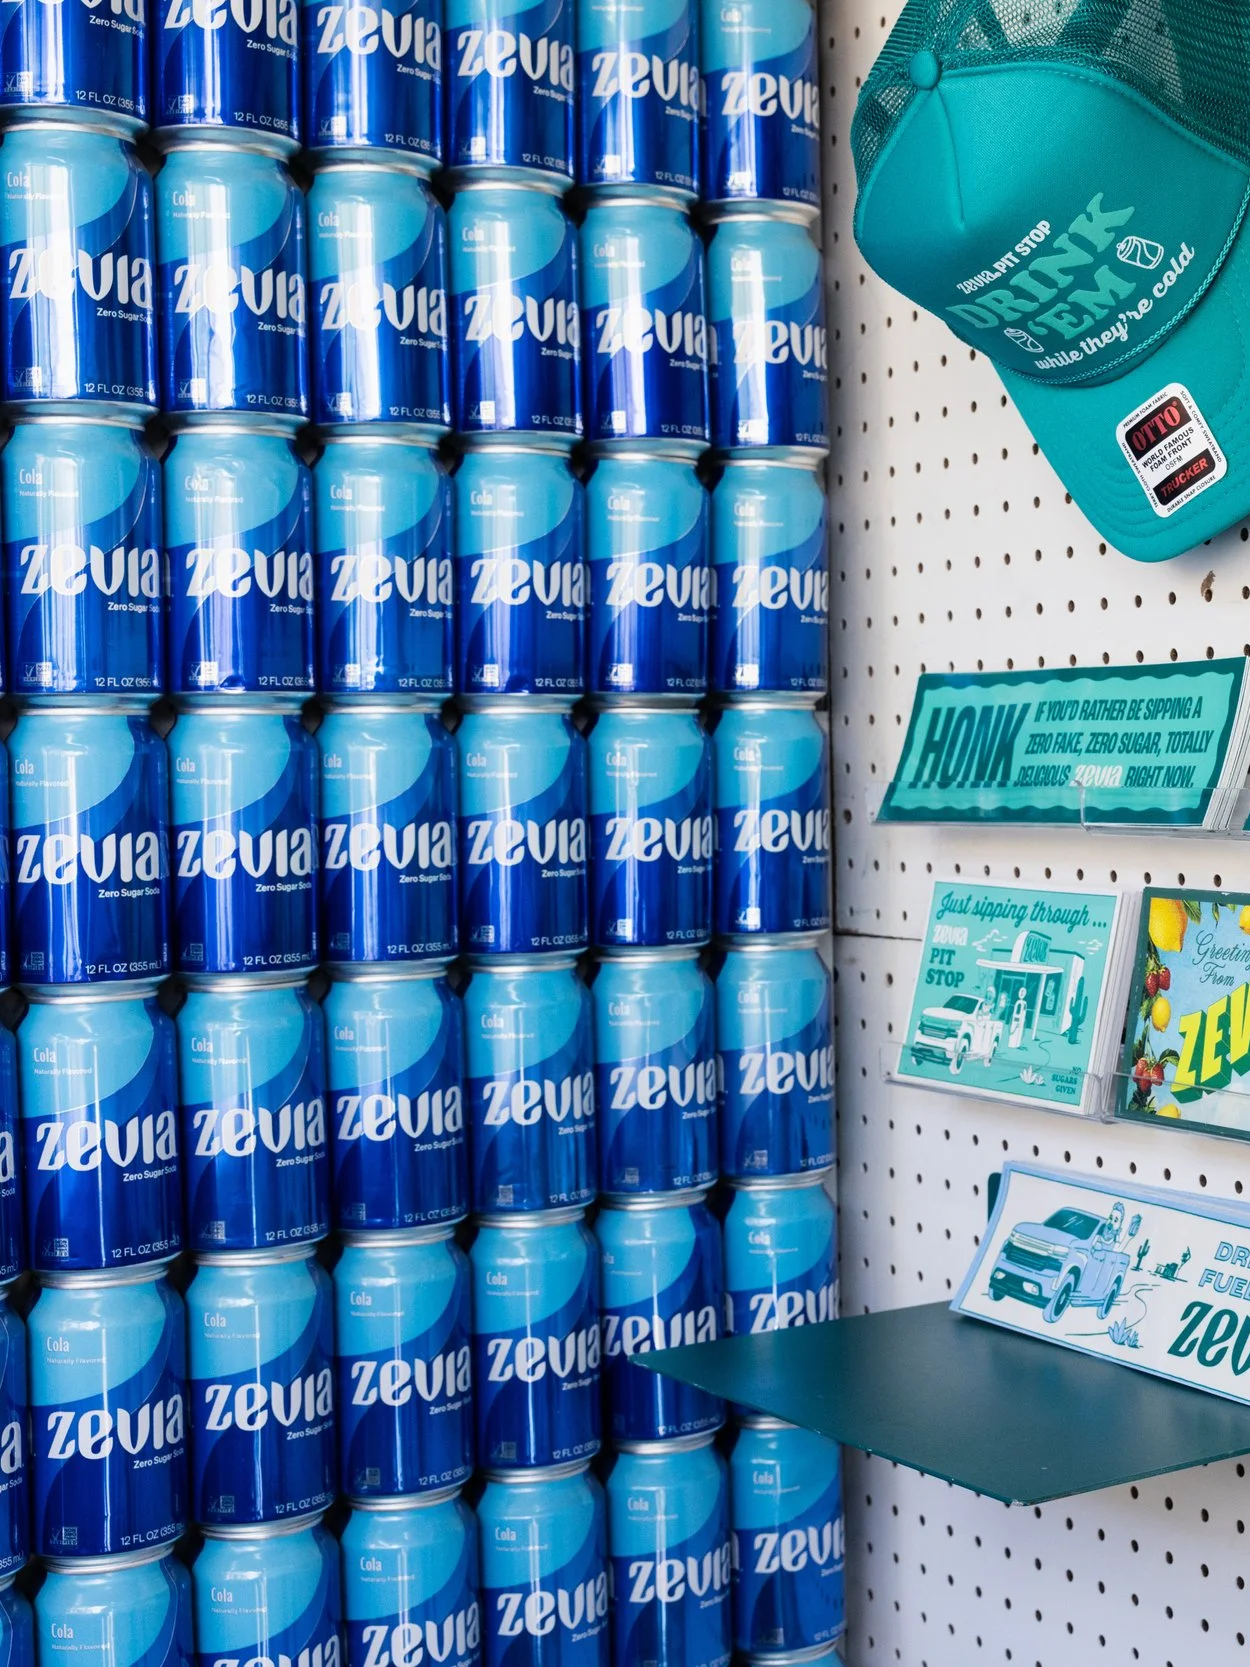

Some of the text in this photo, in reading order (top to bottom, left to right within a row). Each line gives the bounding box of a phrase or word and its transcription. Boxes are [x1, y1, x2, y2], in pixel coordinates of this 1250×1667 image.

[317, 5, 441, 71] zevia
[456, 30, 574, 92] zevia
[945, 192, 1136, 329] DRINK
[993, 251, 1019, 274] PIT
[1015, 220, 1051, 256] STOP
[9, 248, 152, 311] zevia
[174, 264, 306, 324] zevia
[320, 282, 448, 337] zevia
[464, 294, 581, 348] zevia
[1034, 242, 1195, 370] while they're cold
[1122, 392, 1168, 428] PREMIUM FOAM FABRIC
[1132, 406, 1180, 451] OTTO
[1180, 390, 1222, 463] SOFT COMFY SWEATBAND
[1142, 426, 1194, 468] WORLD FAMOUS
[1150, 437, 1193, 472] FOAM FRONT
[1164, 454, 1184, 471] OSFM
[20, 468, 44, 486] Cola
[1122, 442, 1159, 509] TERRY CLOTH SWEATBAND
[1160, 457, 1208, 497] TRUCKER
[1166, 475, 1216, 513] DURABLE SNAP CLOSURE
[20, 544, 161, 598] zevia
[186, 547, 314, 602] zevia
[330, 554, 453, 606] zevia
[470, 557, 588, 606] zevia
[606, 562, 716, 612] zevia
[1034, 696, 1203, 722] IF YOU'D RATHER BE SIPPING A
[912, 702, 1032, 789] HONK
[1024, 730, 1214, 758] ZERO FAKE, ZERO SUGAR, TOTALLY
[1013, 764, 1196, 788] DELICIOUS zevia RIGHT NOW.
[17, 830, 160, 885] zevia
[176, 826, 313, 880] zevia
[324, 823, 452, 872] zevia
[467, 818, 587, 866] zevia
[604, 816, 715, 863] zevia
[98, 886, 160, 900] Zero Sugar Soda
[936, 891, 971, 920] Just
[970, 896, 1030, 928] sipping
[930, 948, 956, 966] PIT
[932, 924, 970, 946] zevia
[84, 961, 148, 975] 12 FL OZ (355
[926, 968, 966, 988] STOP
[1200, 962, 1236, 986] From
[34, 1047, 57, 1064] Cola
[1052, 1074, 1078, 1086] SUGARS
[482, 1072, 596, 1126] zevia
[610, 1054, 721, 1110] zevia
[1055, 1084, 1077, 1096] GIVEN
[194, 1098, 326, 1158] zevia
[336, 1086, 464, 1142] zevia
[36, 1110, 178, 1172] zevia
[111, 1244, 152, 1258] 12 FL OZ
[47, 1336, 70, 1353] Cola
[204, 1312, 227, 1328] Cola
[350, 1344, 472, 1407] zevia
[487, 1323, 601, 1383] zevia
[204, 1368, 333, 1432] zevia
[47, 1393, 184, 1460] zevia
[497, 1570, 609, 1636] zevia
